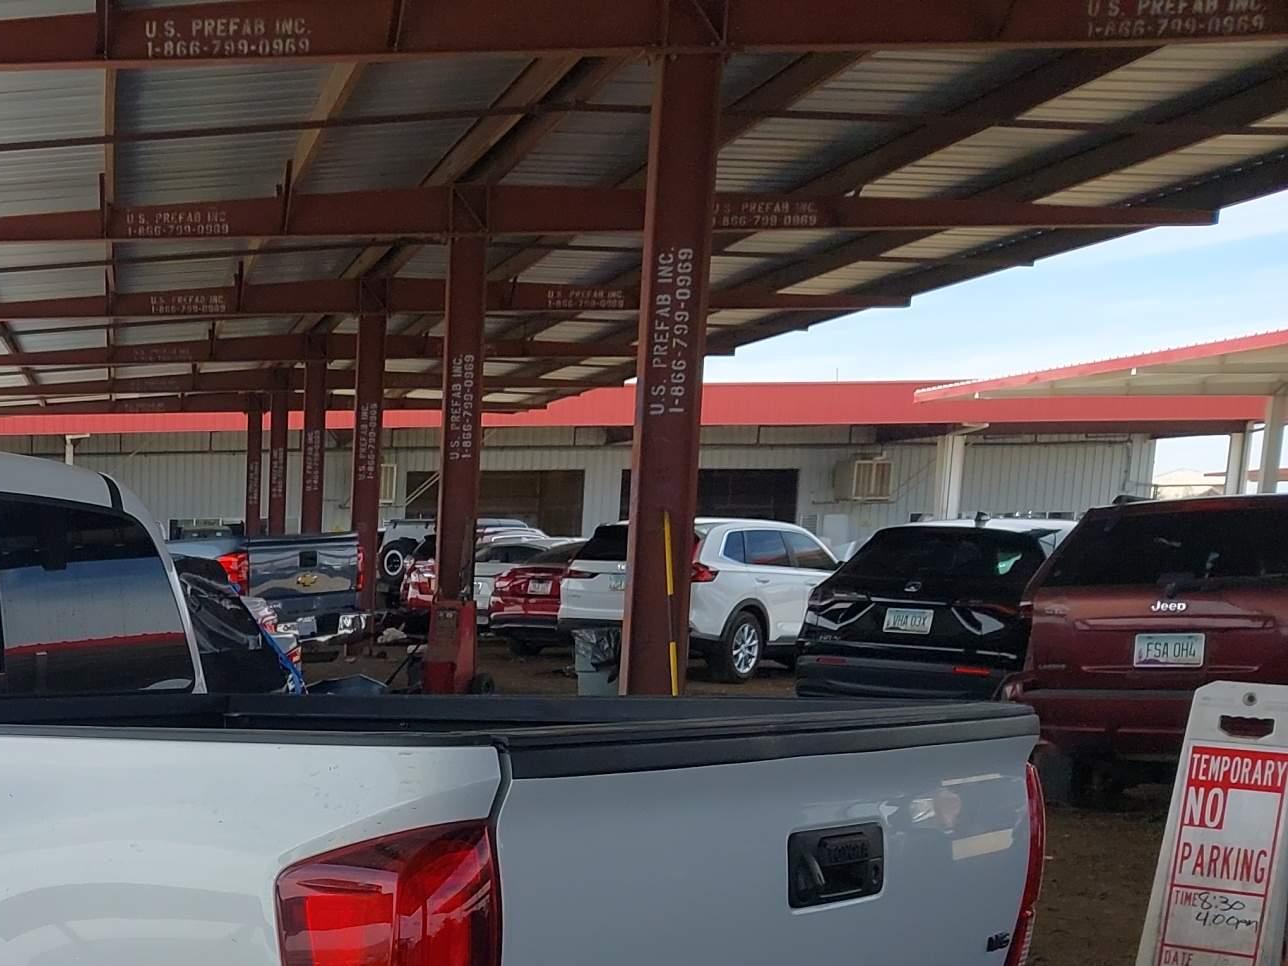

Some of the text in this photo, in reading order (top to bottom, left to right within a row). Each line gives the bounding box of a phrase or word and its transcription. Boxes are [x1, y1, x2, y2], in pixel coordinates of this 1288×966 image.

[192, 18, 265, 37] PREFAB
[275, 17, 312, 35] INC.
[147, 38, 310, 58] 1-866-799-0969
[649, 247, 674, 415] U.S. PREFAB INC.
[669, 247, 694, 413] 1-866-799-0969
[450, 383, 462, 431] PREFAB
[1151, 600, 1187, 613] Jeep
[1146, 642, 1169, 658] FSA
[1191, 753, 1288, 787] TEMPORARY
[1183, 786, 1224, 828] NO
[1178, 841, 1268, 884] PARKING
[1174, 890, 1199, 907] TIME
[1198, 892, 1246, 911] 8:30
